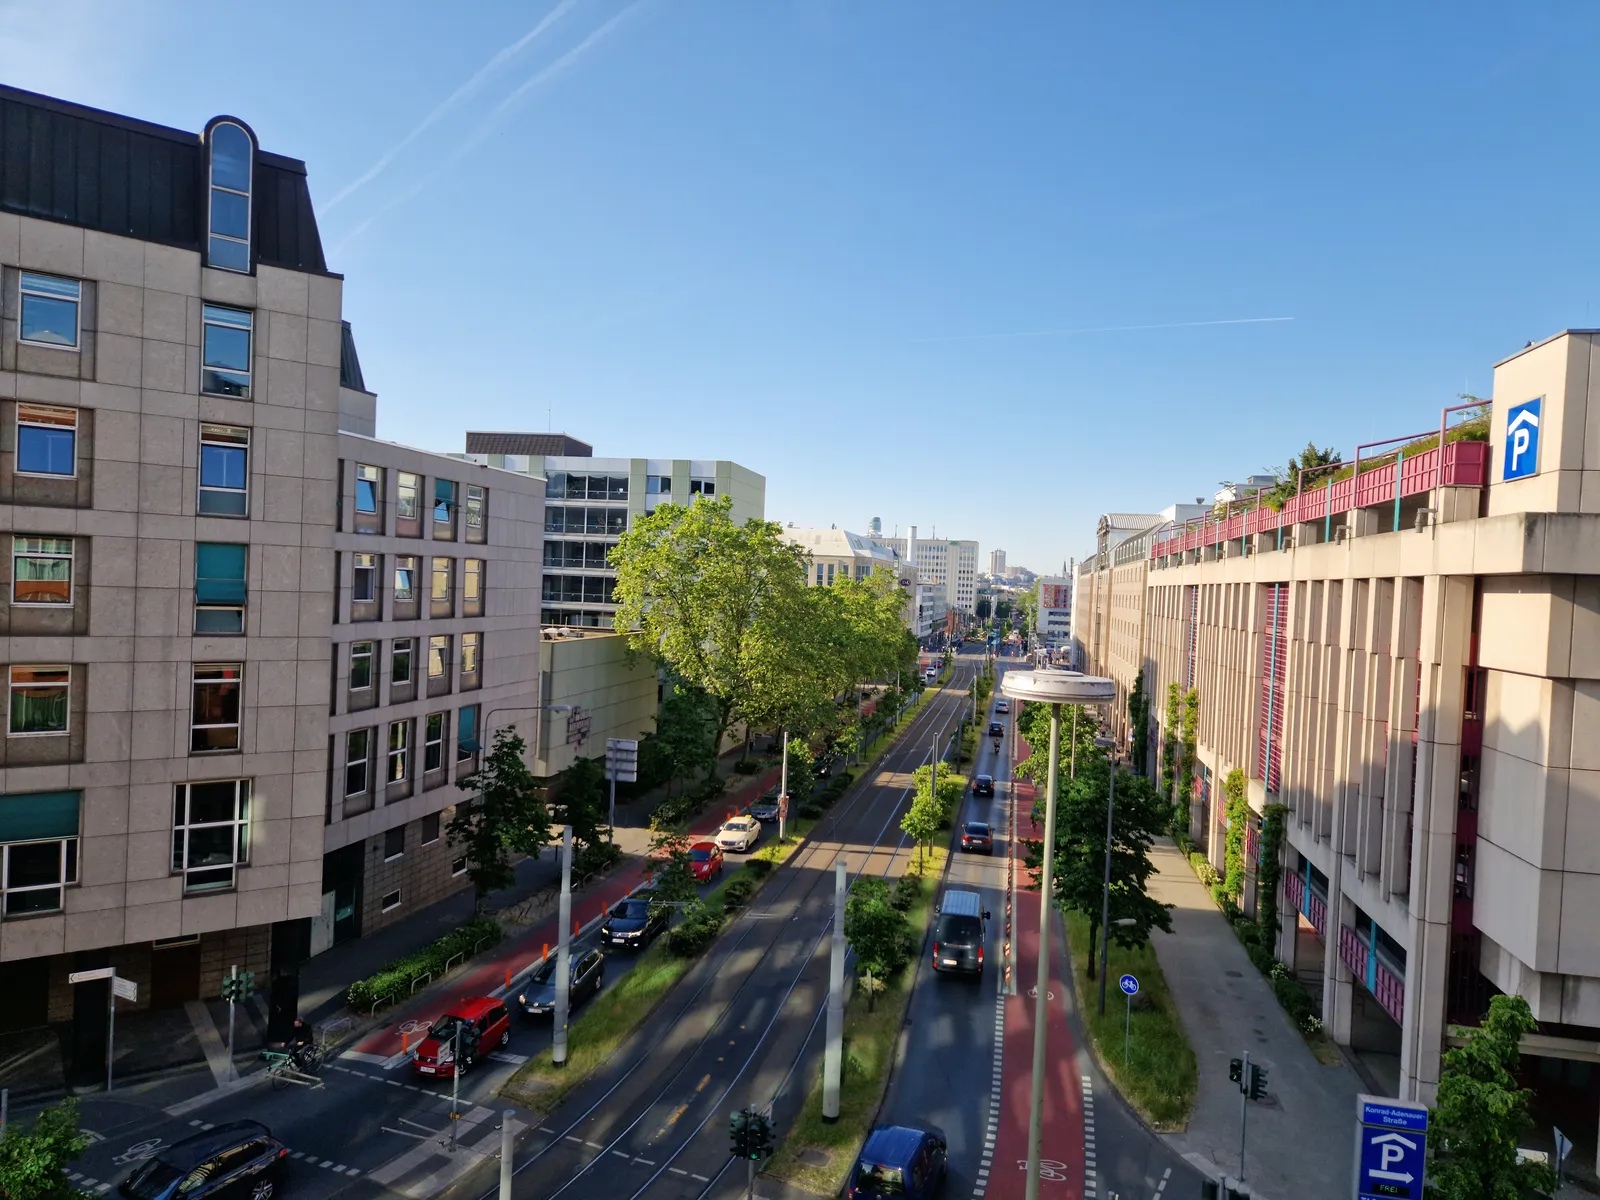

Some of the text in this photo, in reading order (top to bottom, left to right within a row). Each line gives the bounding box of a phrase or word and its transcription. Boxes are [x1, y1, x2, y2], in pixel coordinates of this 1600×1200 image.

[1512, 428, 1530, 471] P
[1365, 1106, 1426, 1119] Konrad-Adenauer-
[1382, 1116, 1408, 1125] Straße
[1381, 1143, 1404, 1171] P
[1380, 1184, 1398, 1193] FREI
